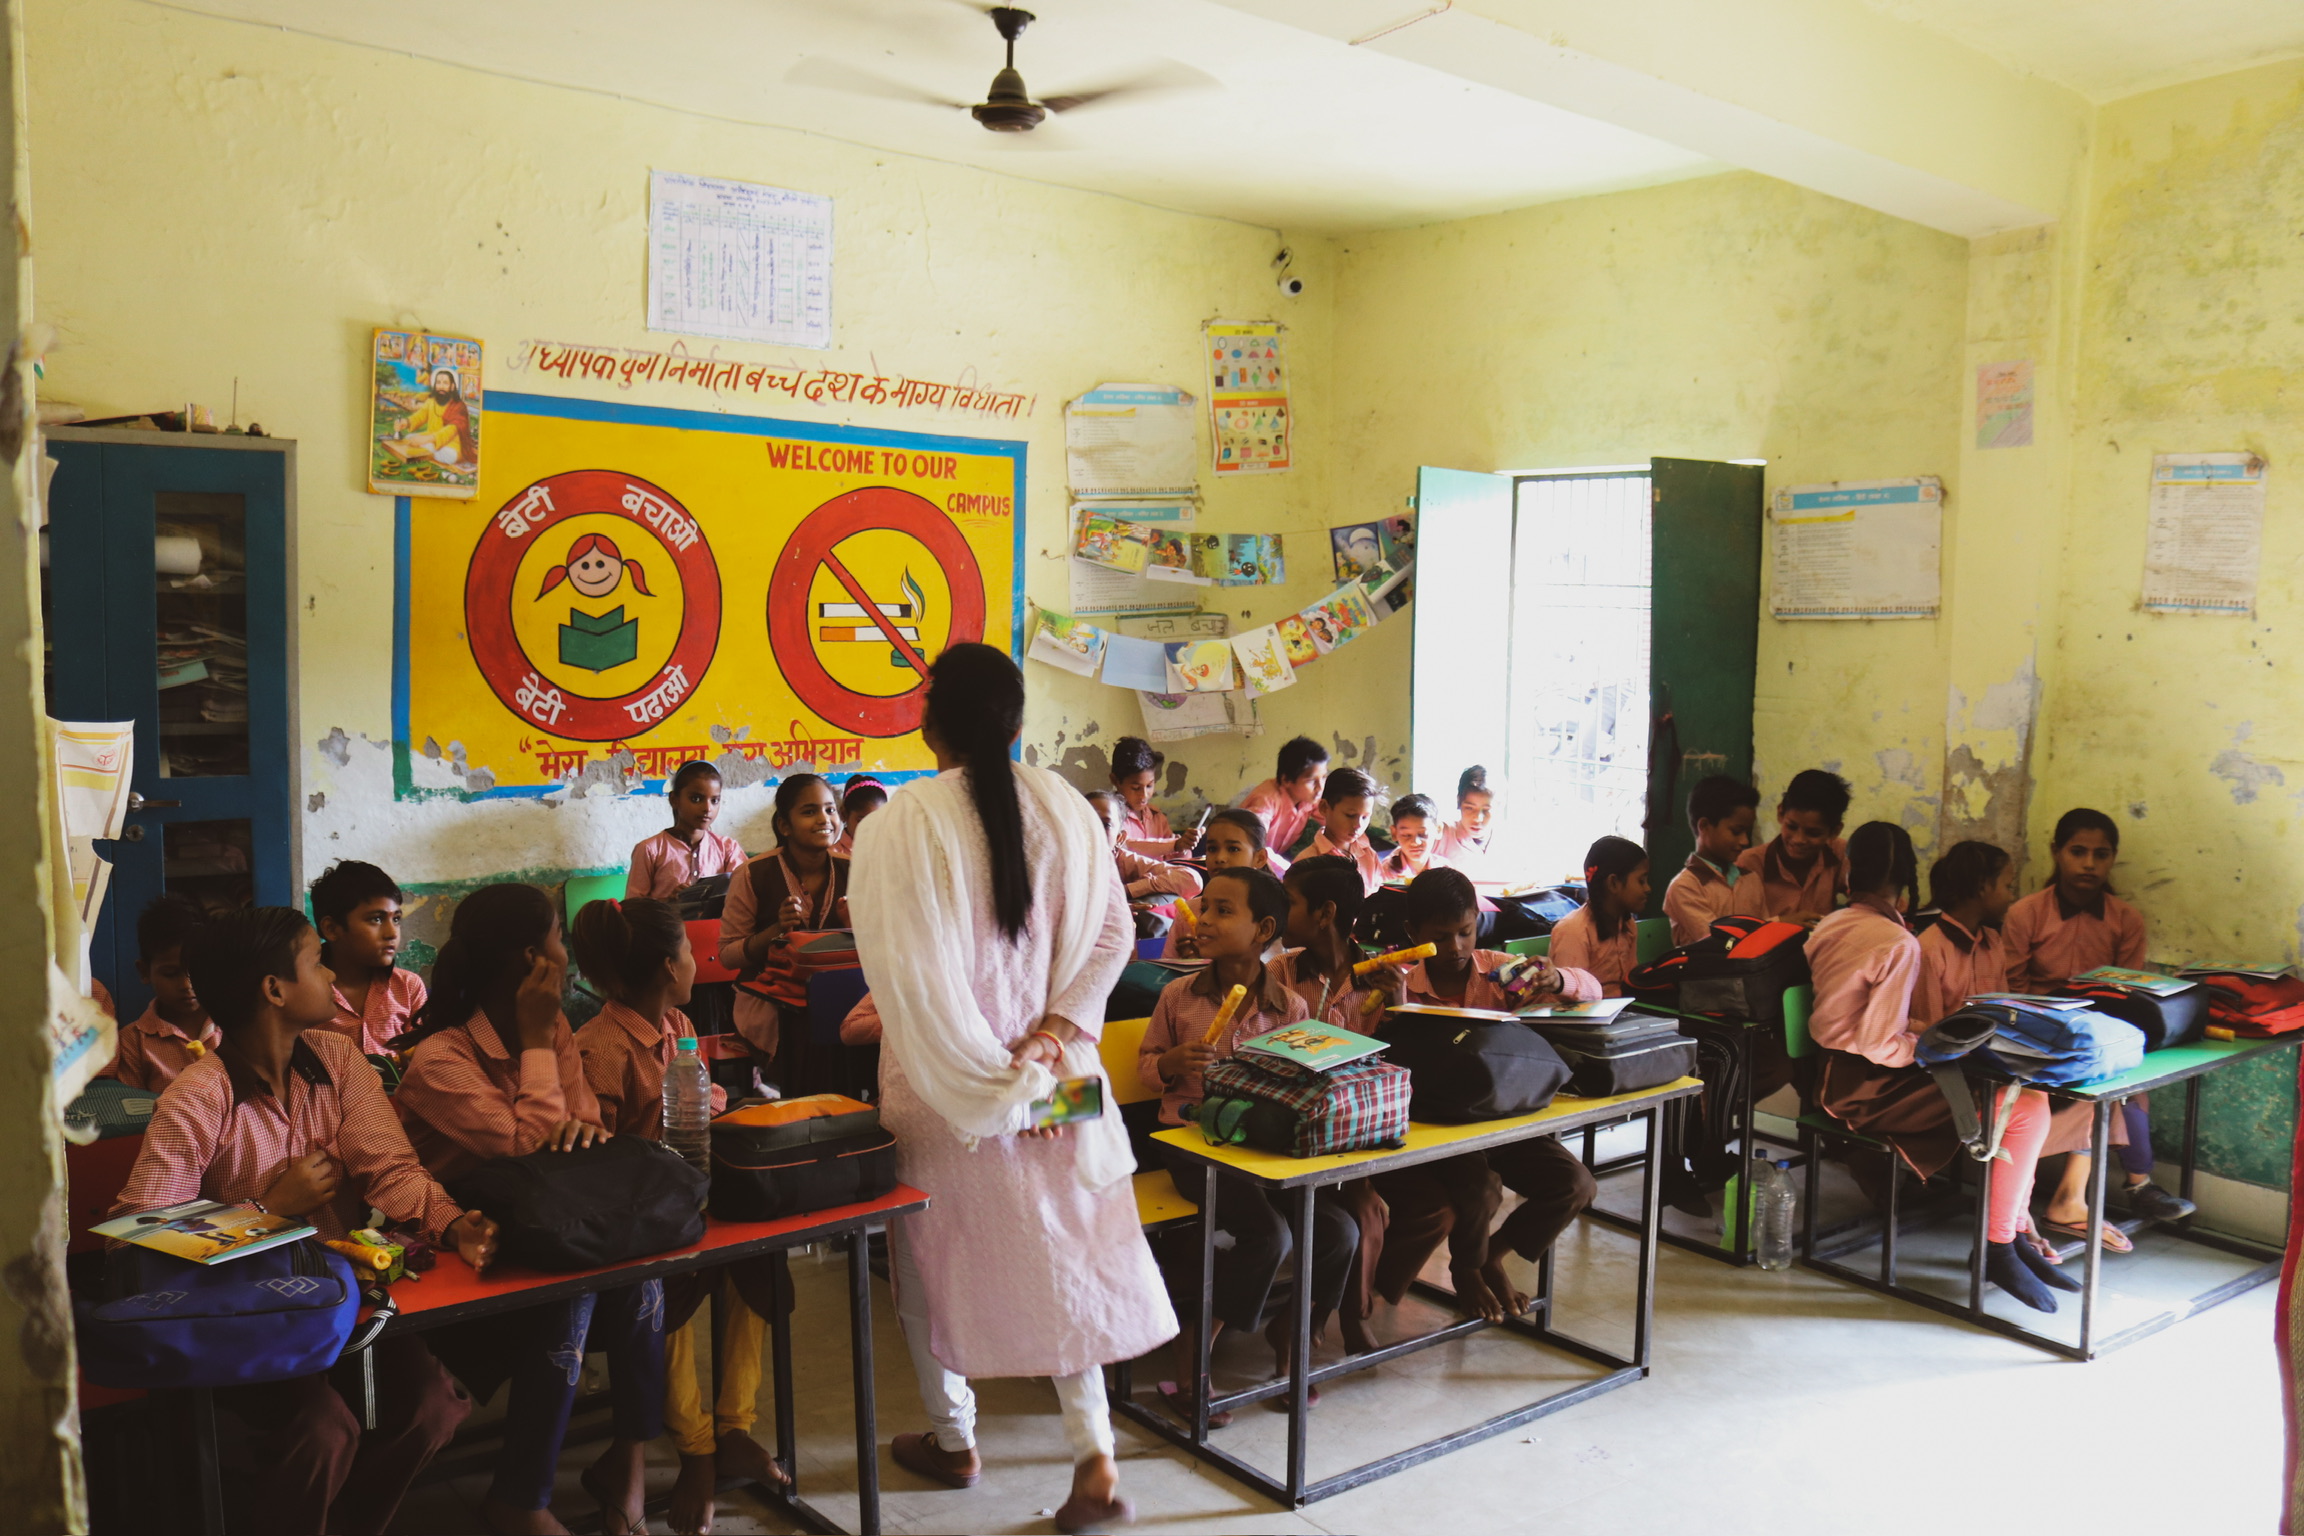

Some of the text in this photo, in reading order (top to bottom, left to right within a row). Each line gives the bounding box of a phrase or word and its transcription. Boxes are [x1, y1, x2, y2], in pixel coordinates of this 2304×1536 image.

[619, 348, 662, 389] युग
[804, 360, 864, 406] देश
[861, 351, 890, 404] के
[891, 374, 951, 411] भाग्य
[766, 442, 957, 480] WELCOME TO OUR
[498, 483, 699, 552] बेटी बचाओ
[947, 493, 1010, 517] CAMPUS
[515, 672, 566, 725] बेटी
